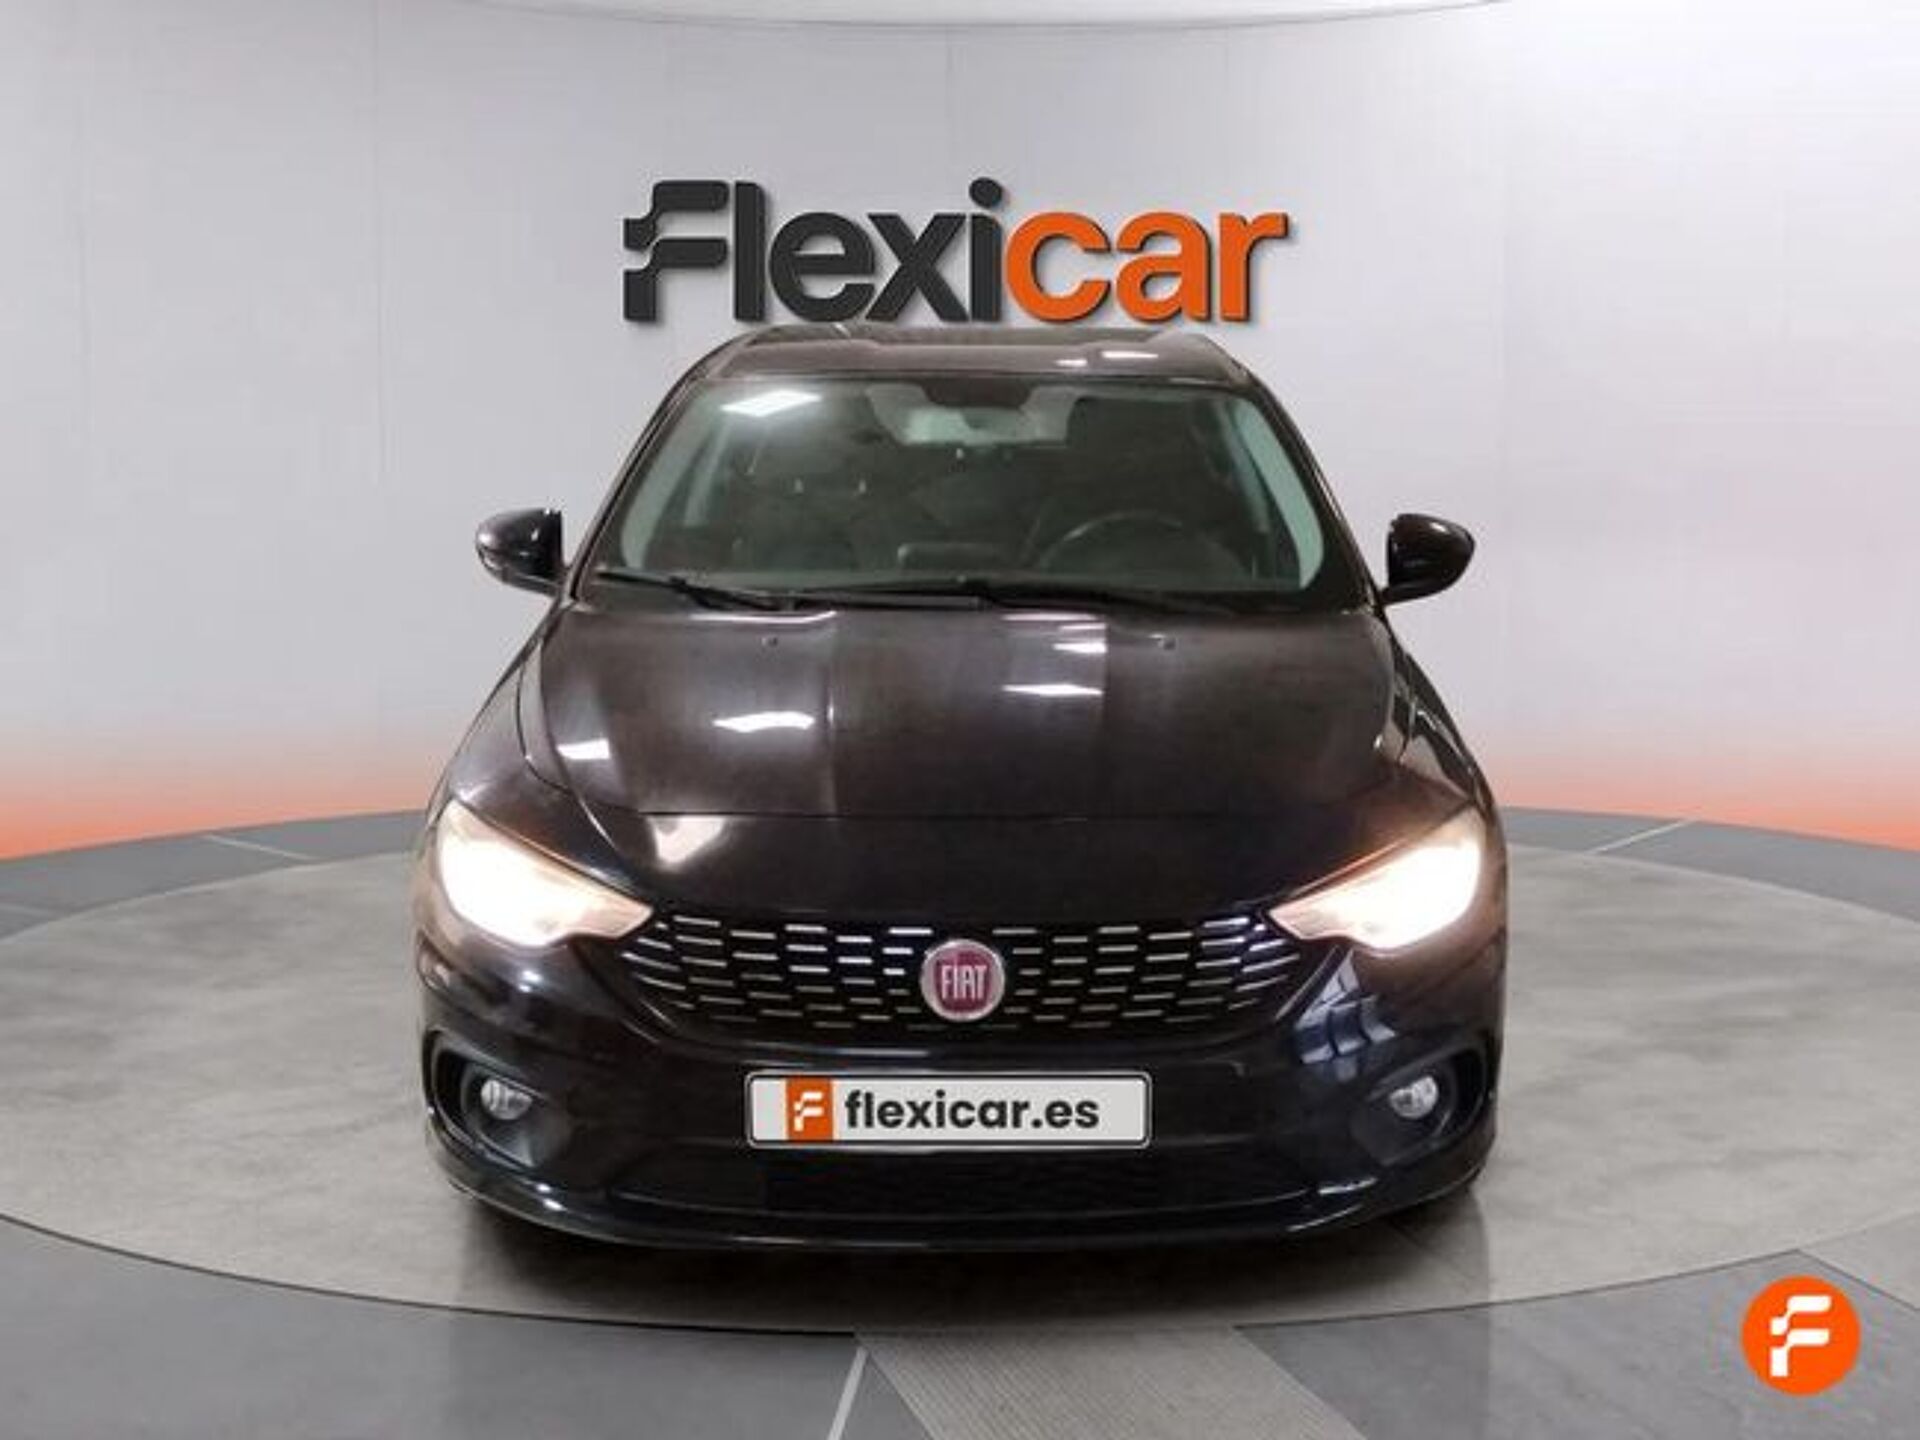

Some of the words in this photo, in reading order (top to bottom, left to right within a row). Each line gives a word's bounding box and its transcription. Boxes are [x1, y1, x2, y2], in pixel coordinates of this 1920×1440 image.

[623, 177, 1288, 322] Flexicar
[941, 964, 987, 1000] FIAT
[845, 1089, 1100, 1129] flexicar.es
